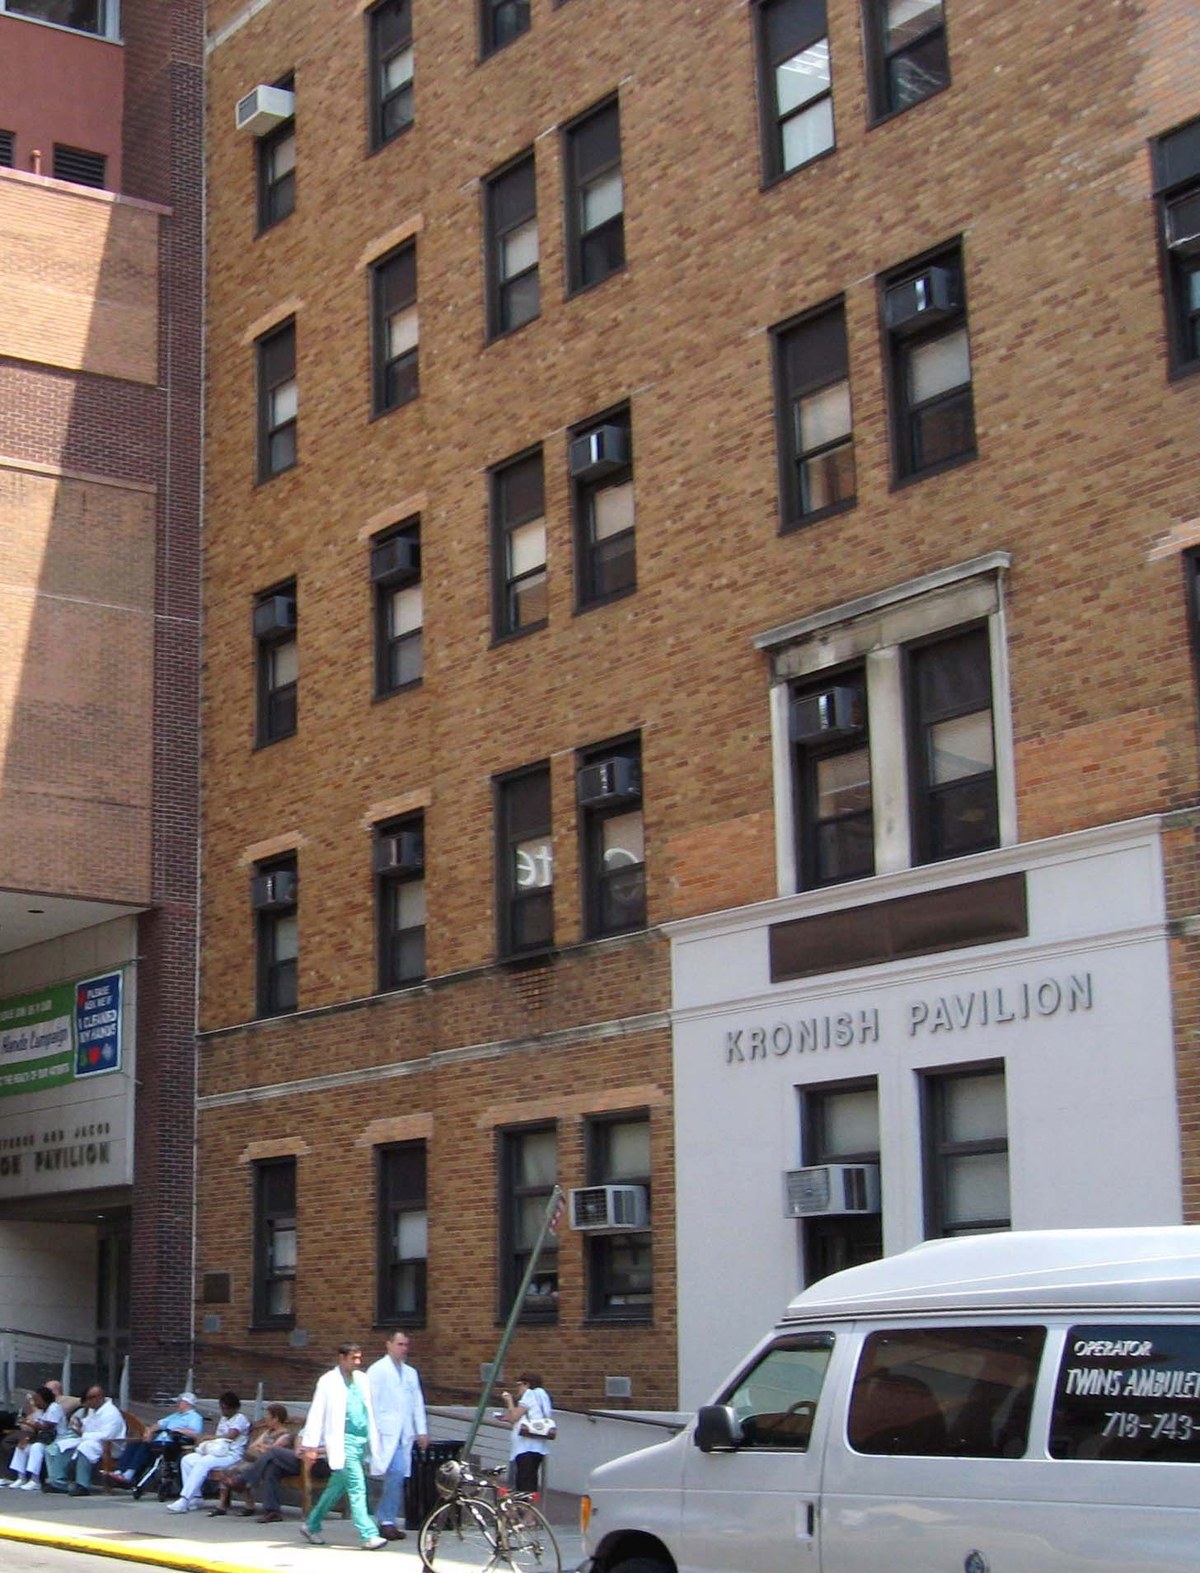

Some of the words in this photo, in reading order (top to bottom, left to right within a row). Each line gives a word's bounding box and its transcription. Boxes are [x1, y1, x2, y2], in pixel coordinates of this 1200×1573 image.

[725, 1008, 880, 1063] KRONISH
[909, 972, 1094, 1037] PAVILION
[35, 1141, 112, 1172] PAVILION
[1073, 1340, 1152, 1356] OPERATOR
[1065, 1367, 1123, 1396] TWINS
